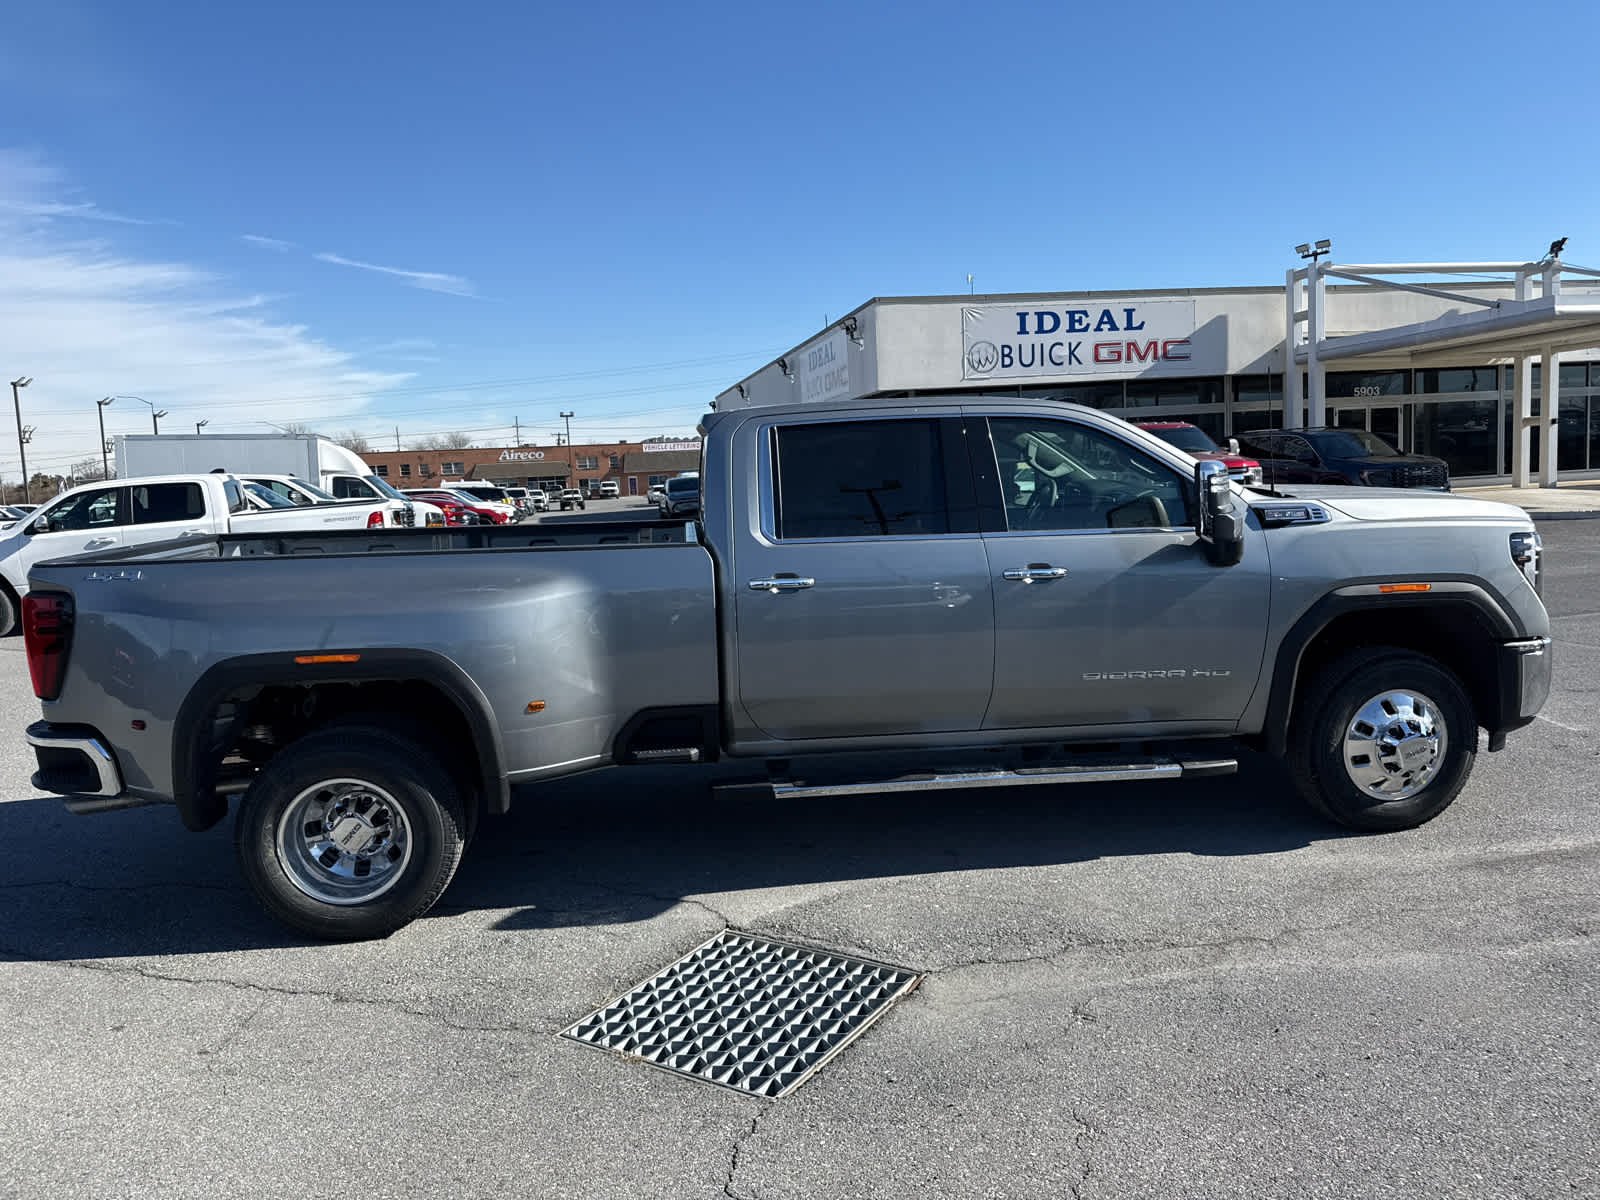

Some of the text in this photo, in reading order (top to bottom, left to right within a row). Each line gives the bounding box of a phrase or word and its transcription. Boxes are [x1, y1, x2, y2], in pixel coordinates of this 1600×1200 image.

[1016, 308, 1145, 335] IDEAL
[808, 341, 836, 372] IDEAL
[1001, 339, 1191, 368] BUICK GMC
[1353, 386, 1380, 397] 5903
[499, 449, 544, 460] Aireco
[643, 442, 700, 451] VEHICLE LETTERING
[1082, 669, 1186, 680] SIERRA
[342, 823, 362, 845] GMC
